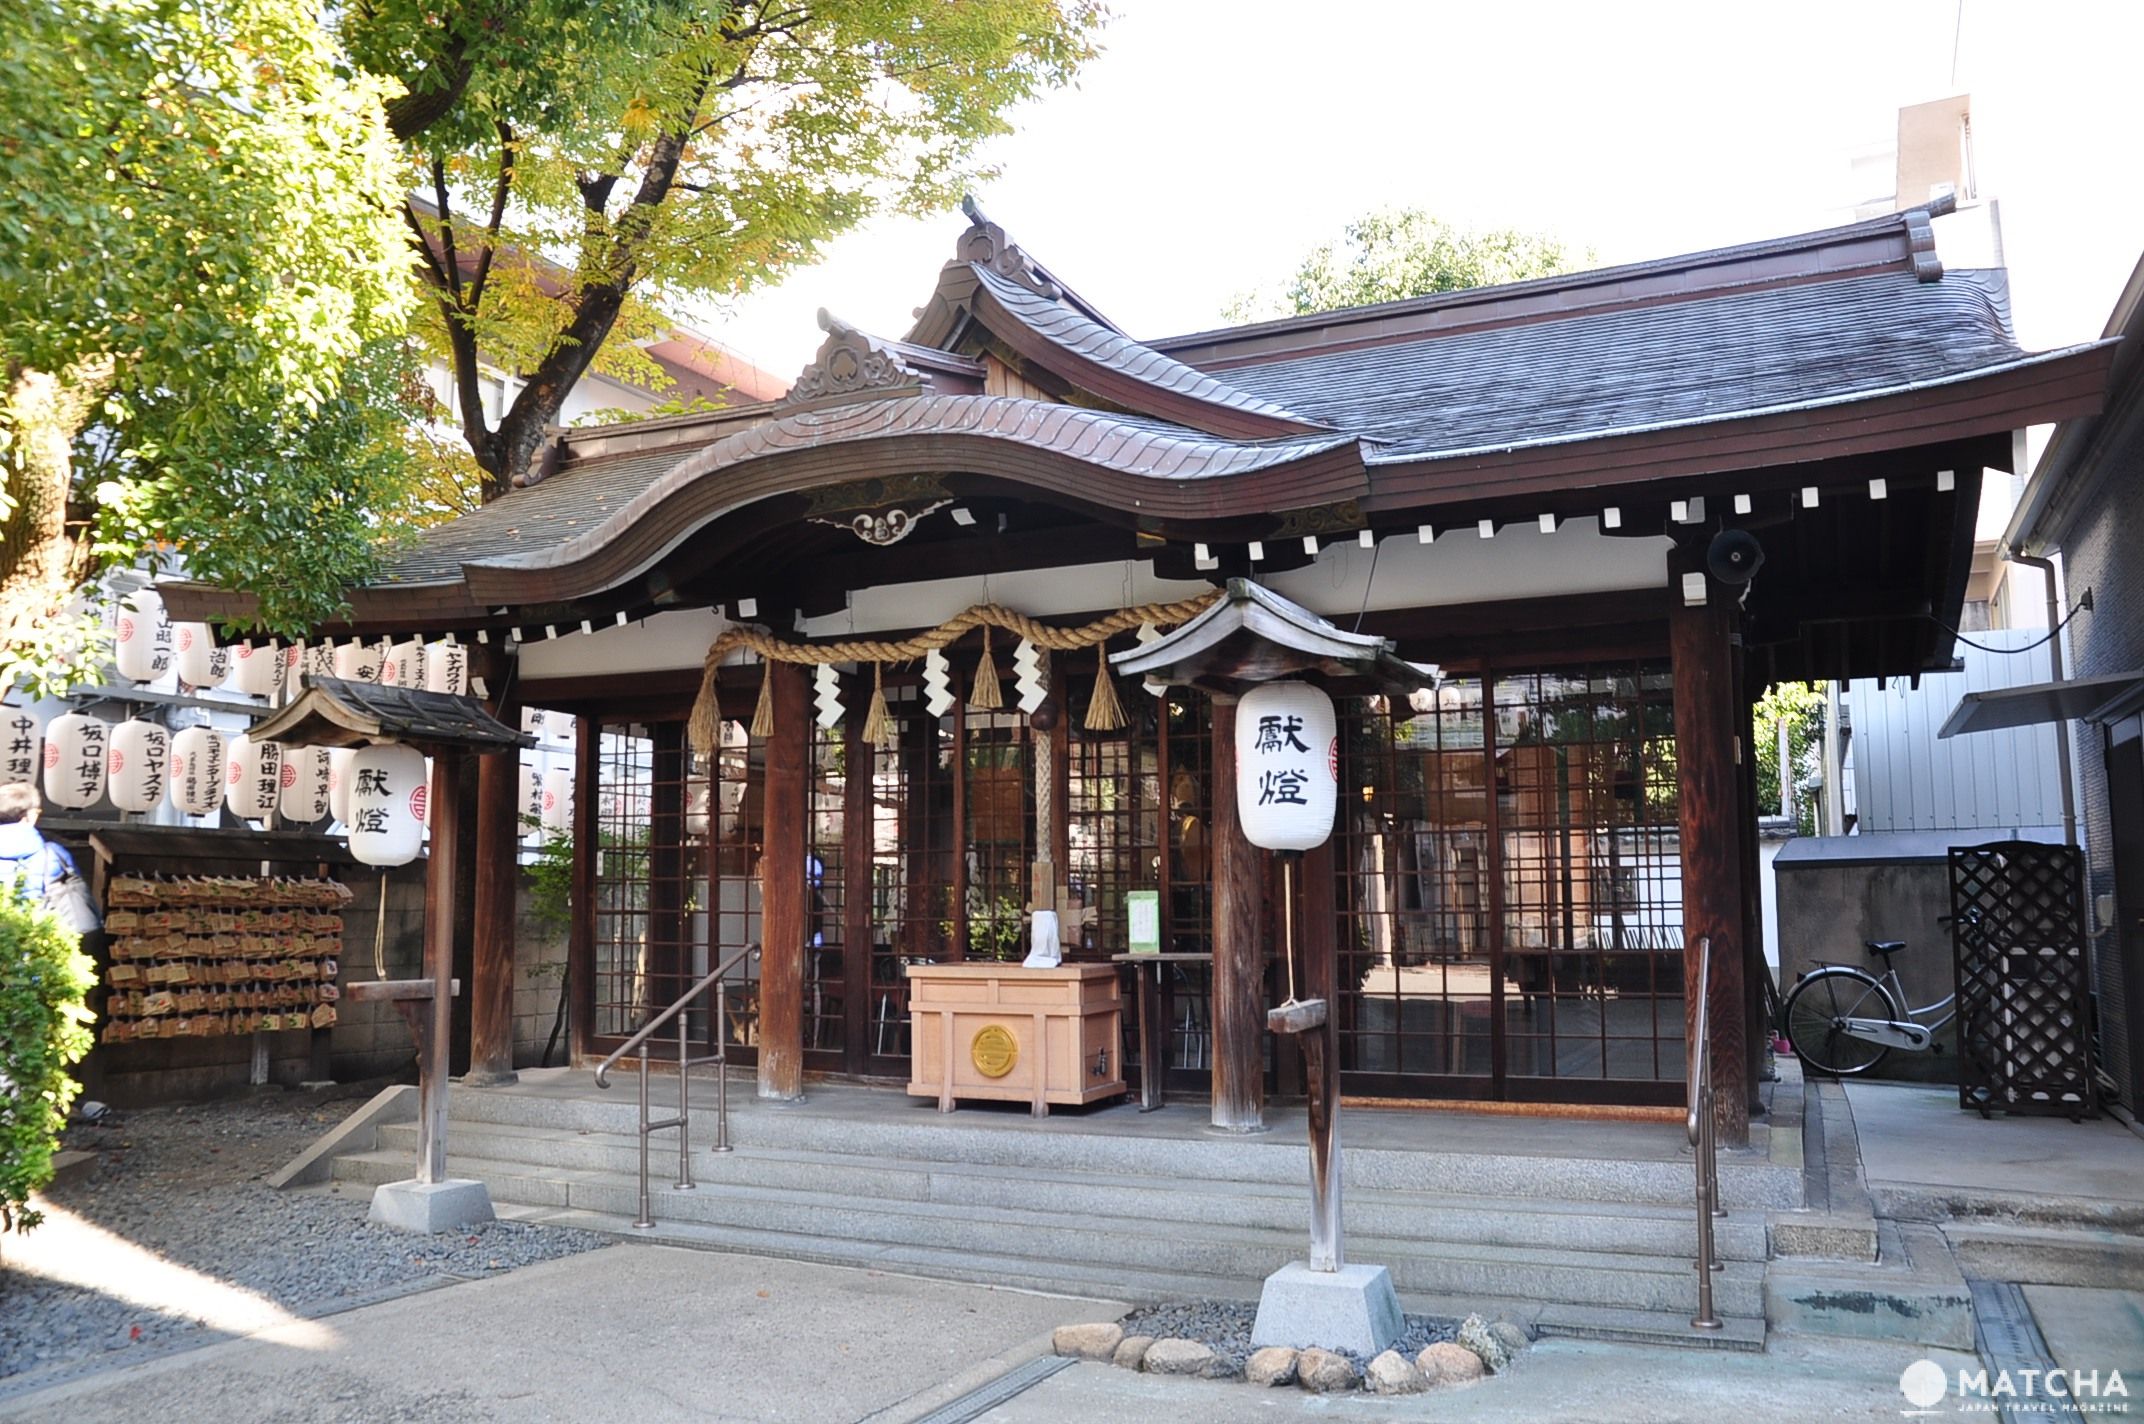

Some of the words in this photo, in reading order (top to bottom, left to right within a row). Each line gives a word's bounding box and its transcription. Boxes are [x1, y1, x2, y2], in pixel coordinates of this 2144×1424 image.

[209, 647, 228, 678] 治郎
[7, 715, 35, 784] 中井理
[75, 723, 105, 798] 坂口博子
[141, 730, 166, 802] 坂口ヤス子
[256, 743, 280, 810] 勝田理江
